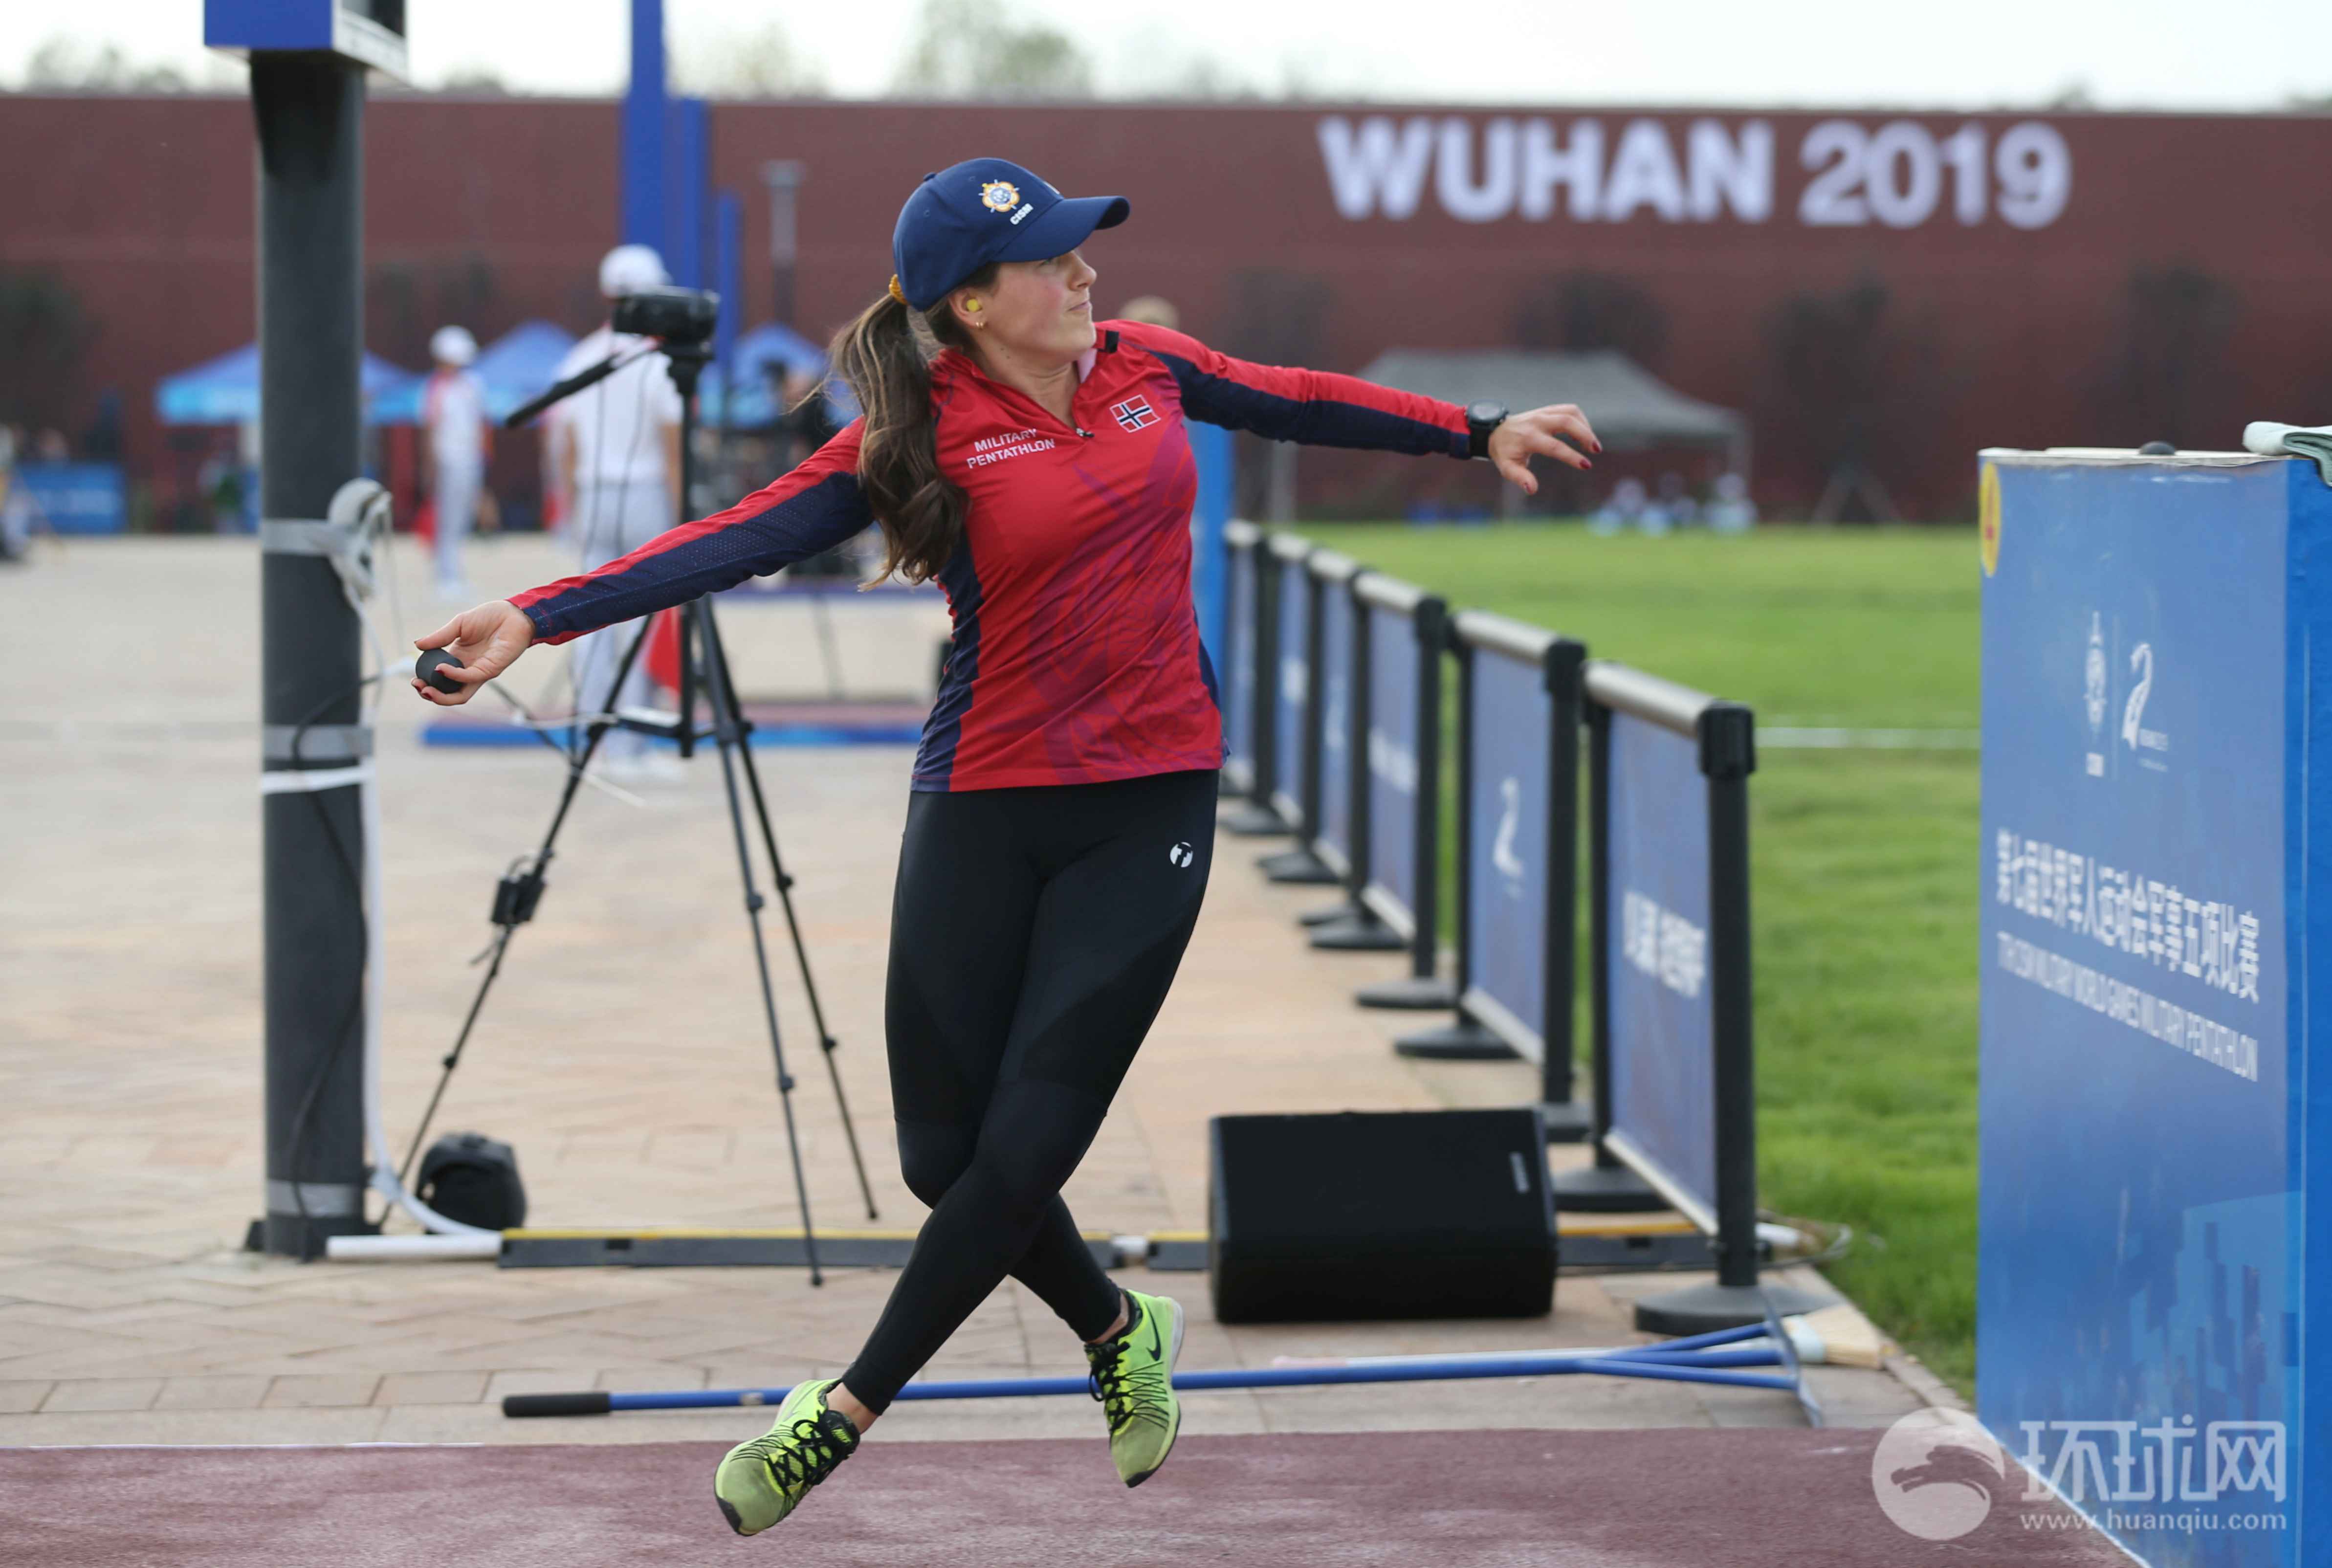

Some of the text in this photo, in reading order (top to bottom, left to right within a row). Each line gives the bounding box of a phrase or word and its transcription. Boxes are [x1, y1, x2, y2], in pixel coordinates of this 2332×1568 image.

[1317, 117, 2072, 229] WUHAN 2019
[1010, 202, 1034, 225] CISM
[966, 439, 1056, 469] PENTATHLON
[974, 428, 1037, 452] MILITARY
[1997, 828, 2259, 1003] 第七届世界军人运动会军事五项比赛
